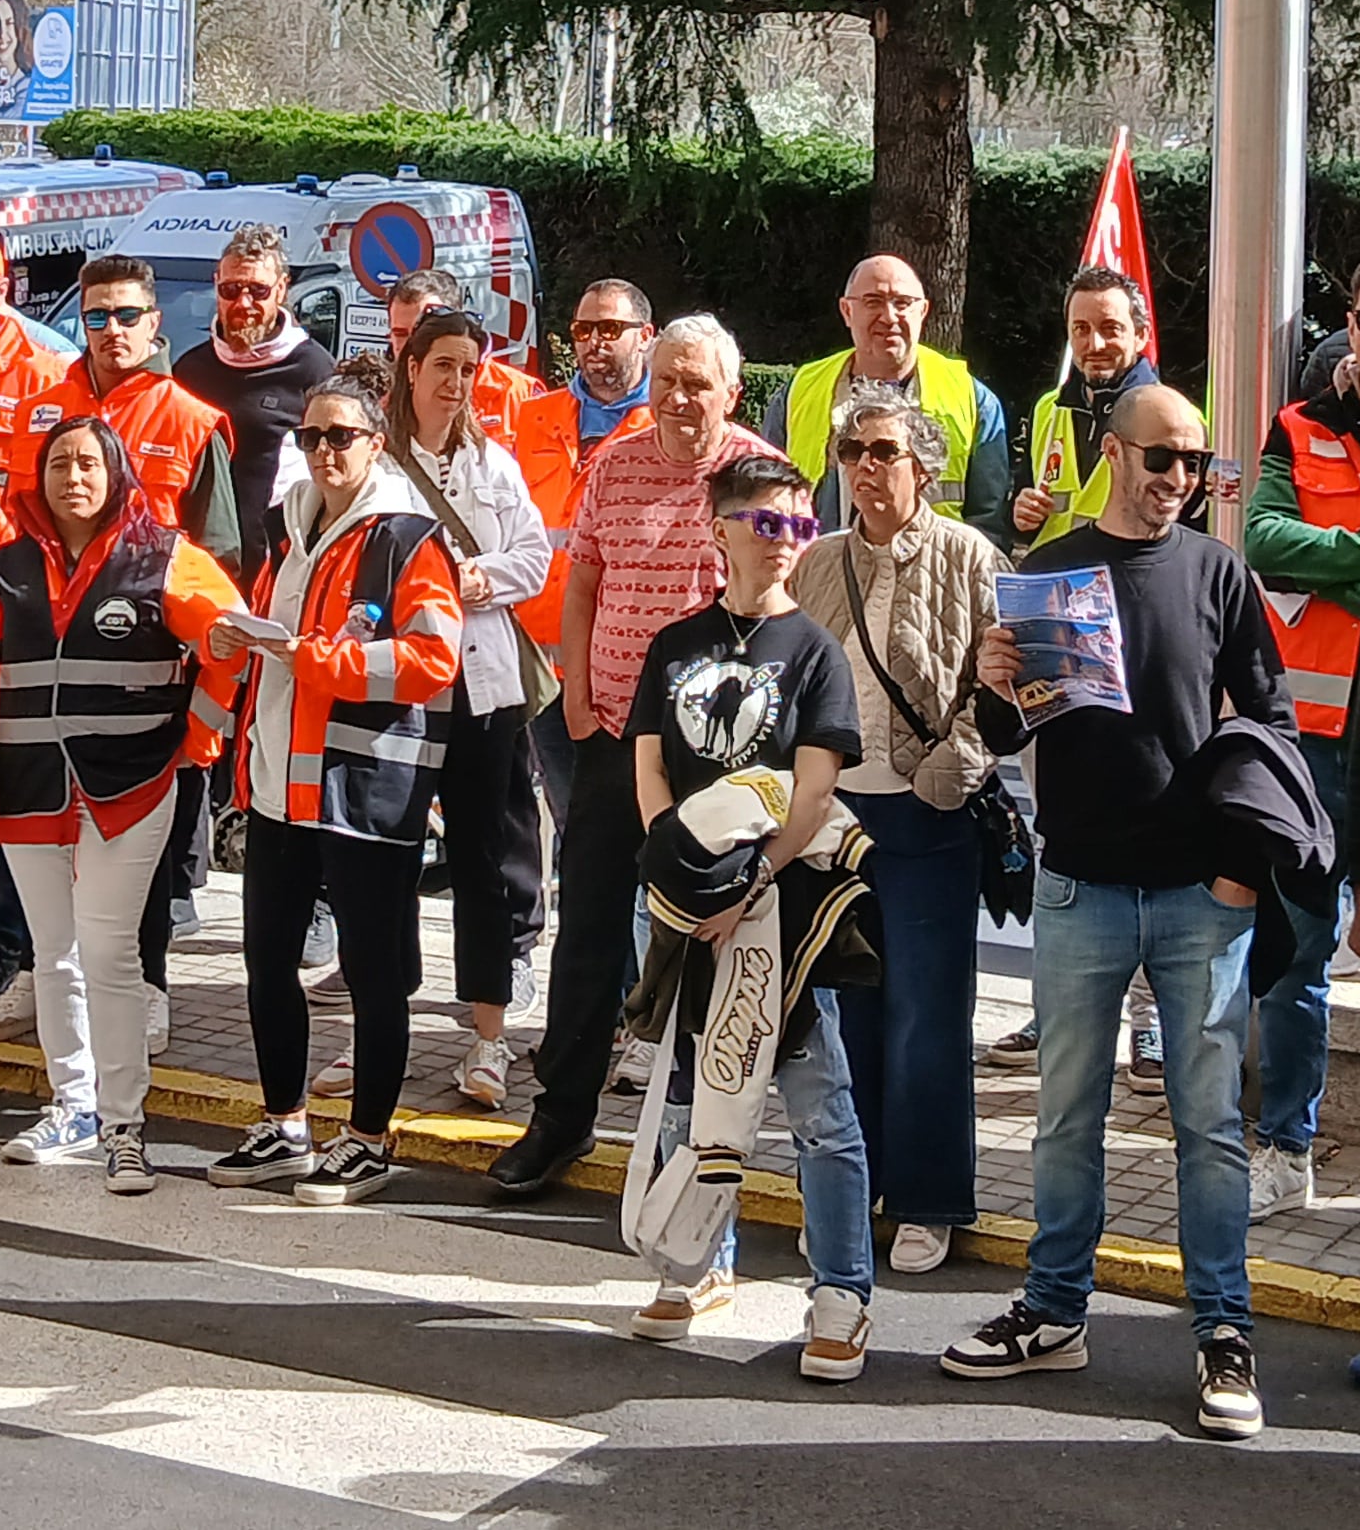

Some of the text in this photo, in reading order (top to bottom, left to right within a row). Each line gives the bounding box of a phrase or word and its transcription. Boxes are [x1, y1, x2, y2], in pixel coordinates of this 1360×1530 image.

[3, 227, 114, 260] MBULANCIA
[105, 617, 127, 626] CGT
[748, 665, 773, 689] CGT
